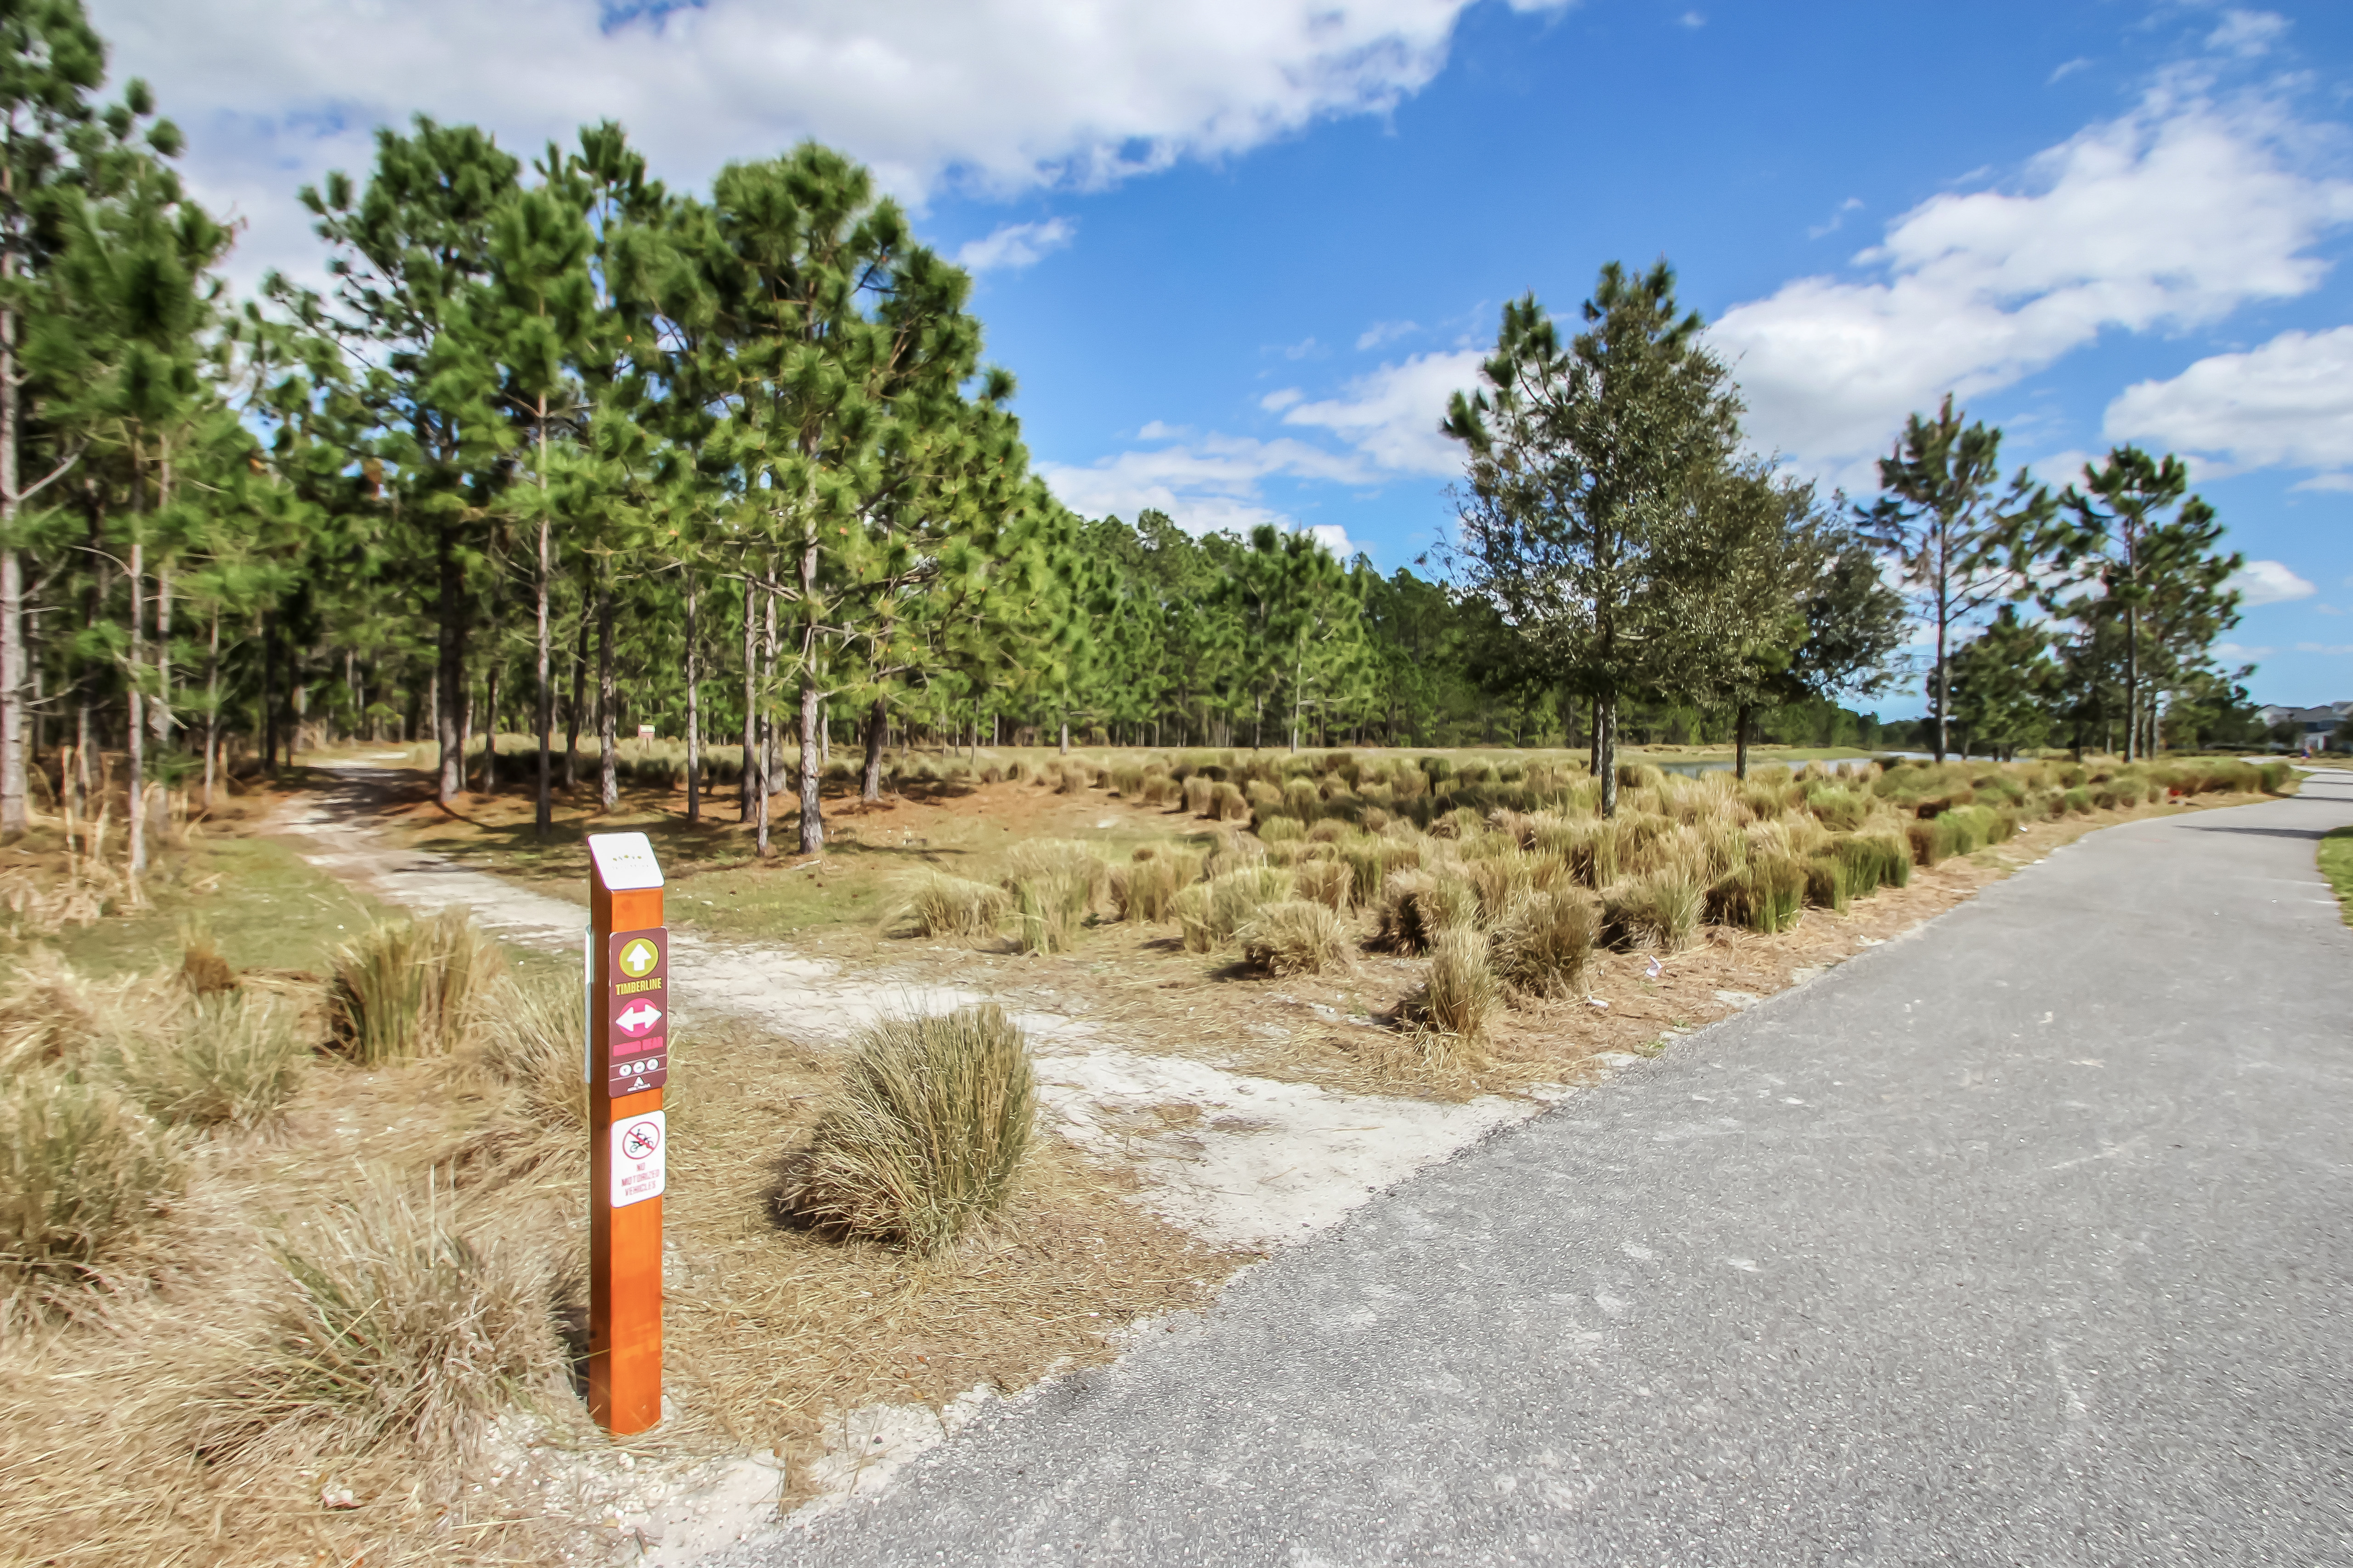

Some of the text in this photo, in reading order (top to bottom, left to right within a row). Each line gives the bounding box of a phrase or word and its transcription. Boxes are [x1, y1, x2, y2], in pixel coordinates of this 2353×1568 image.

[616, 977, 662, 996] TIMBERLINE
[637, 1162, 645, 1172] NO
[622, 1169, 660, 1186] MOTORIZED
[625, 1180, 656, 1196] VEHICLES
